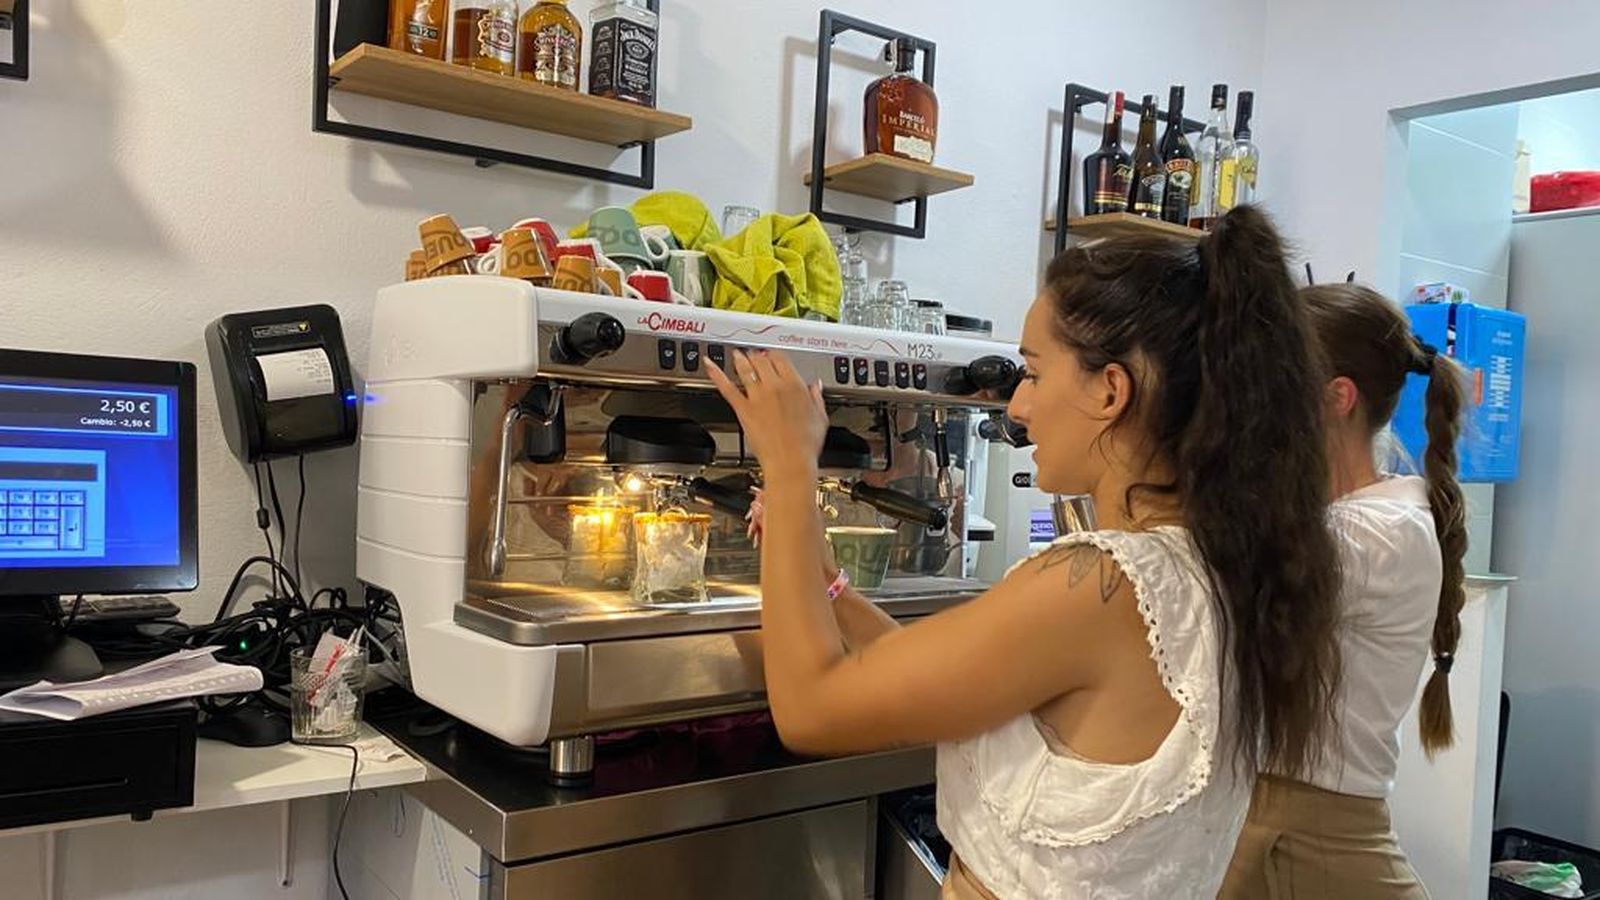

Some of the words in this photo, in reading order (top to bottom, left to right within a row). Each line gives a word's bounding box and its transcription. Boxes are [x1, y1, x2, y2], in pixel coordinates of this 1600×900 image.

[648, 312, 706, 334] CIMBALI
[777, 333, 804, 344] coffee
[806, 336, 829, 346] starts
[907, 342, 936, 361] M23
[100, 399, 136, 414] 2,50
[139, 402, 151, 414] €
[80, 416, 117, 426] Cambio:
[119, 418, 143, 428] -2,50
[144, 419, 151, 428] €
